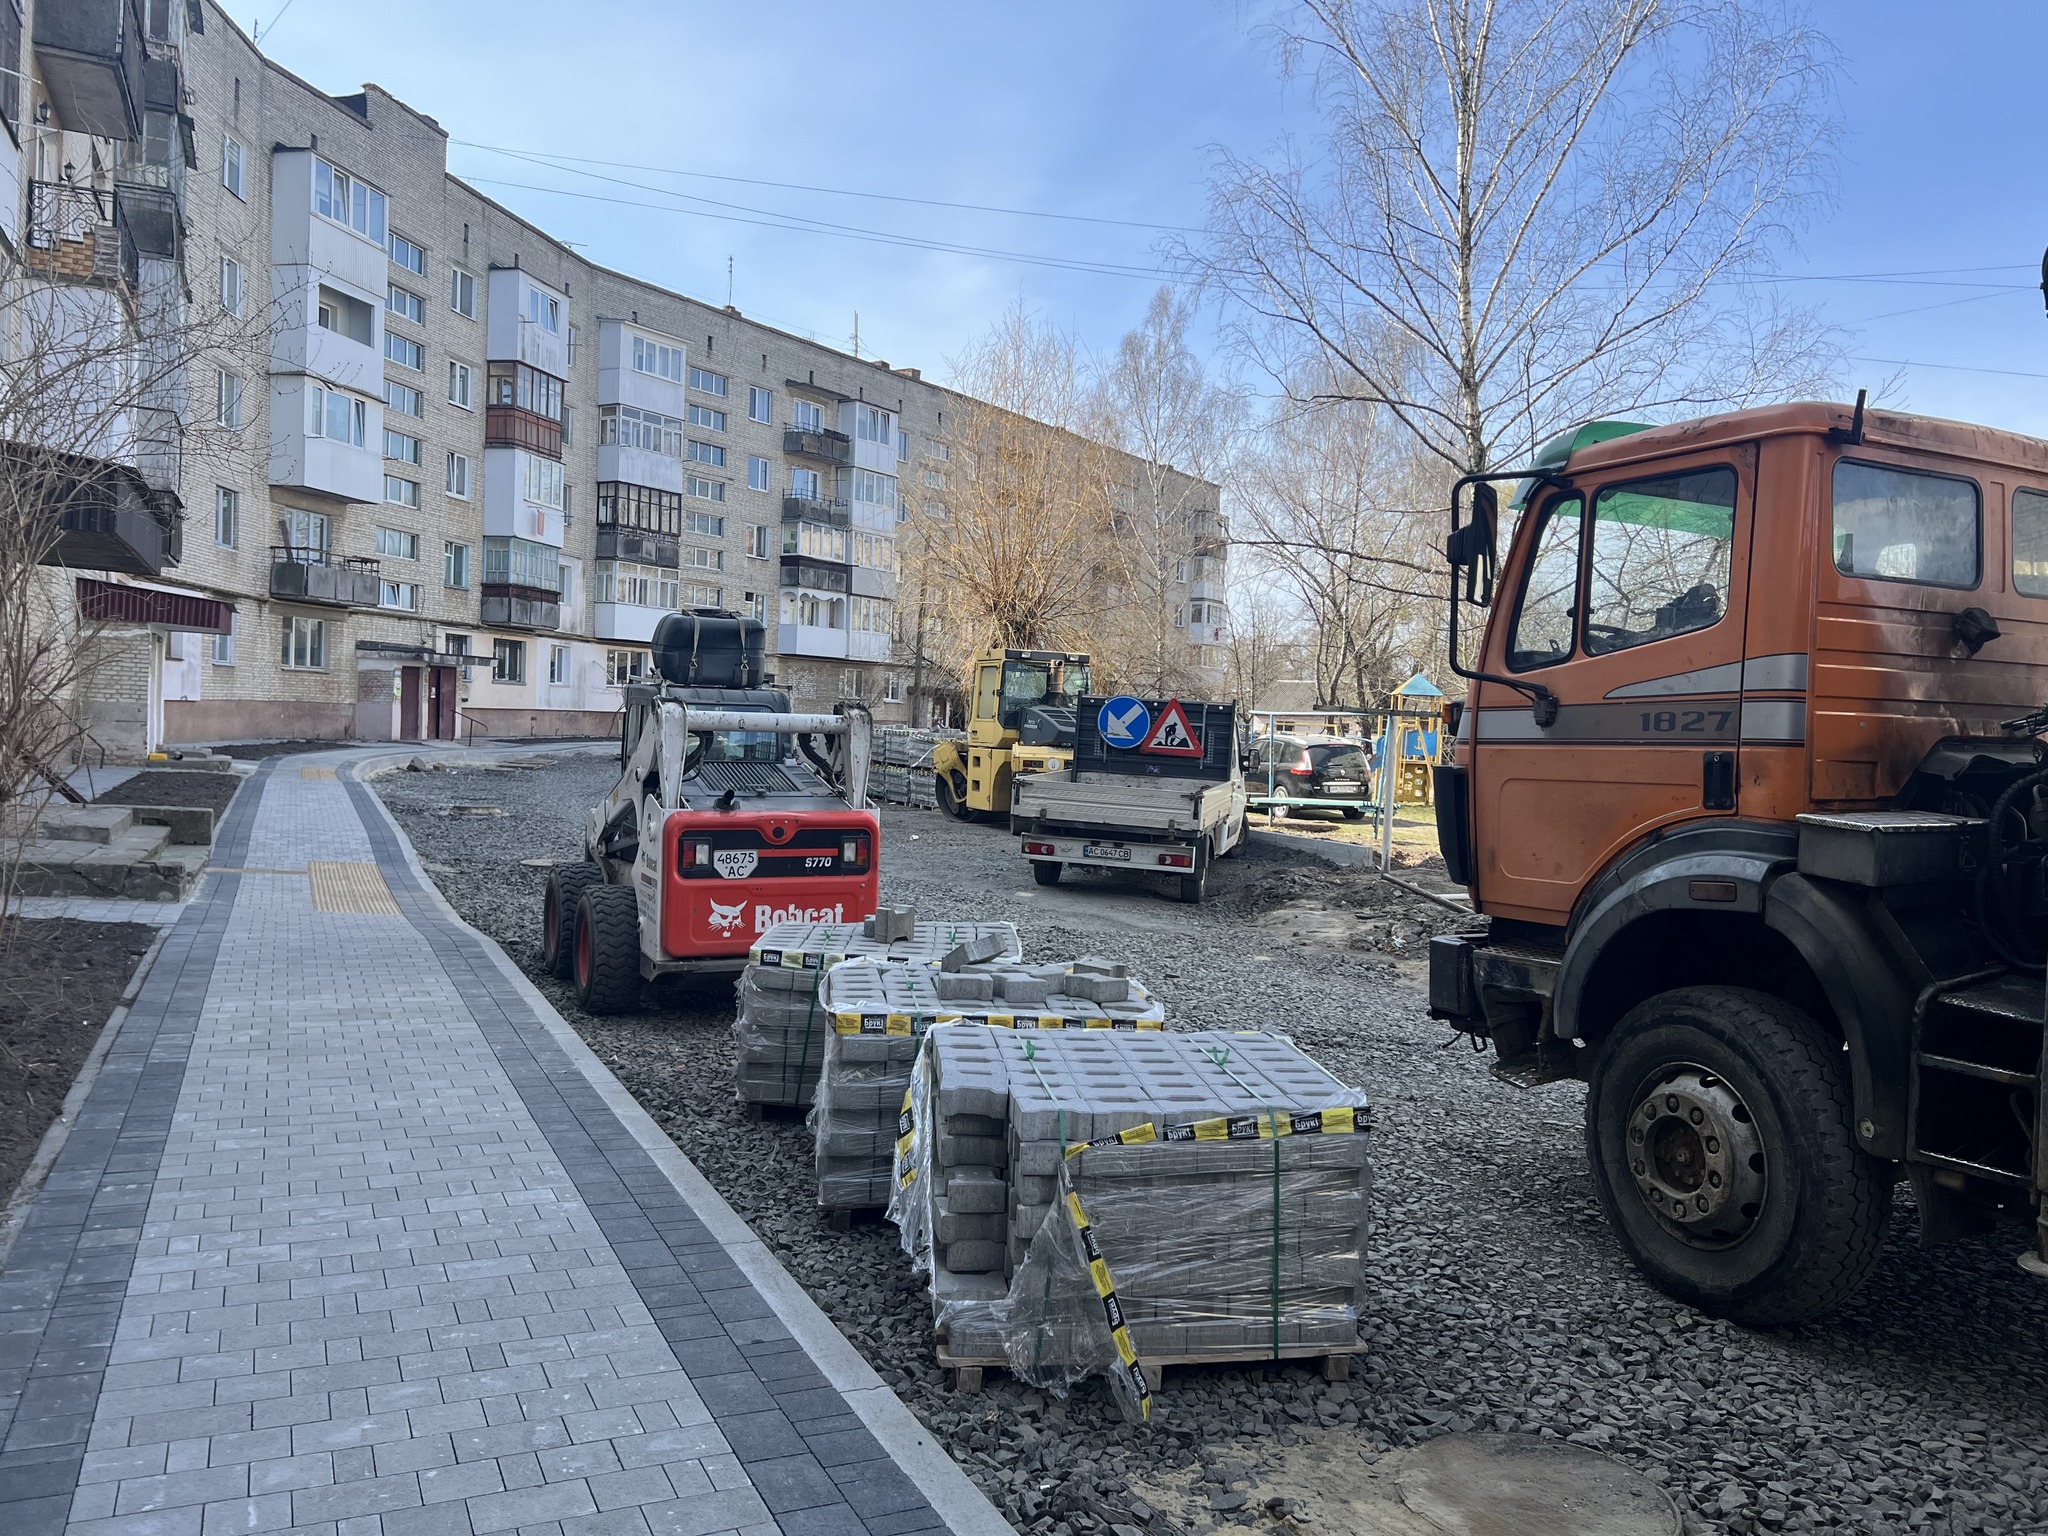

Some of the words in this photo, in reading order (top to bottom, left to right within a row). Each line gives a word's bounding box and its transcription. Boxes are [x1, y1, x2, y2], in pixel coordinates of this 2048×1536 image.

[1640, 711, 1733, 732] 1827
[717, 852, 755, 865] 48675
[804, 856, 832, 868] S770
[727, 866, 745, 877] AC
[754, 903, 844, 934] Bobcat
